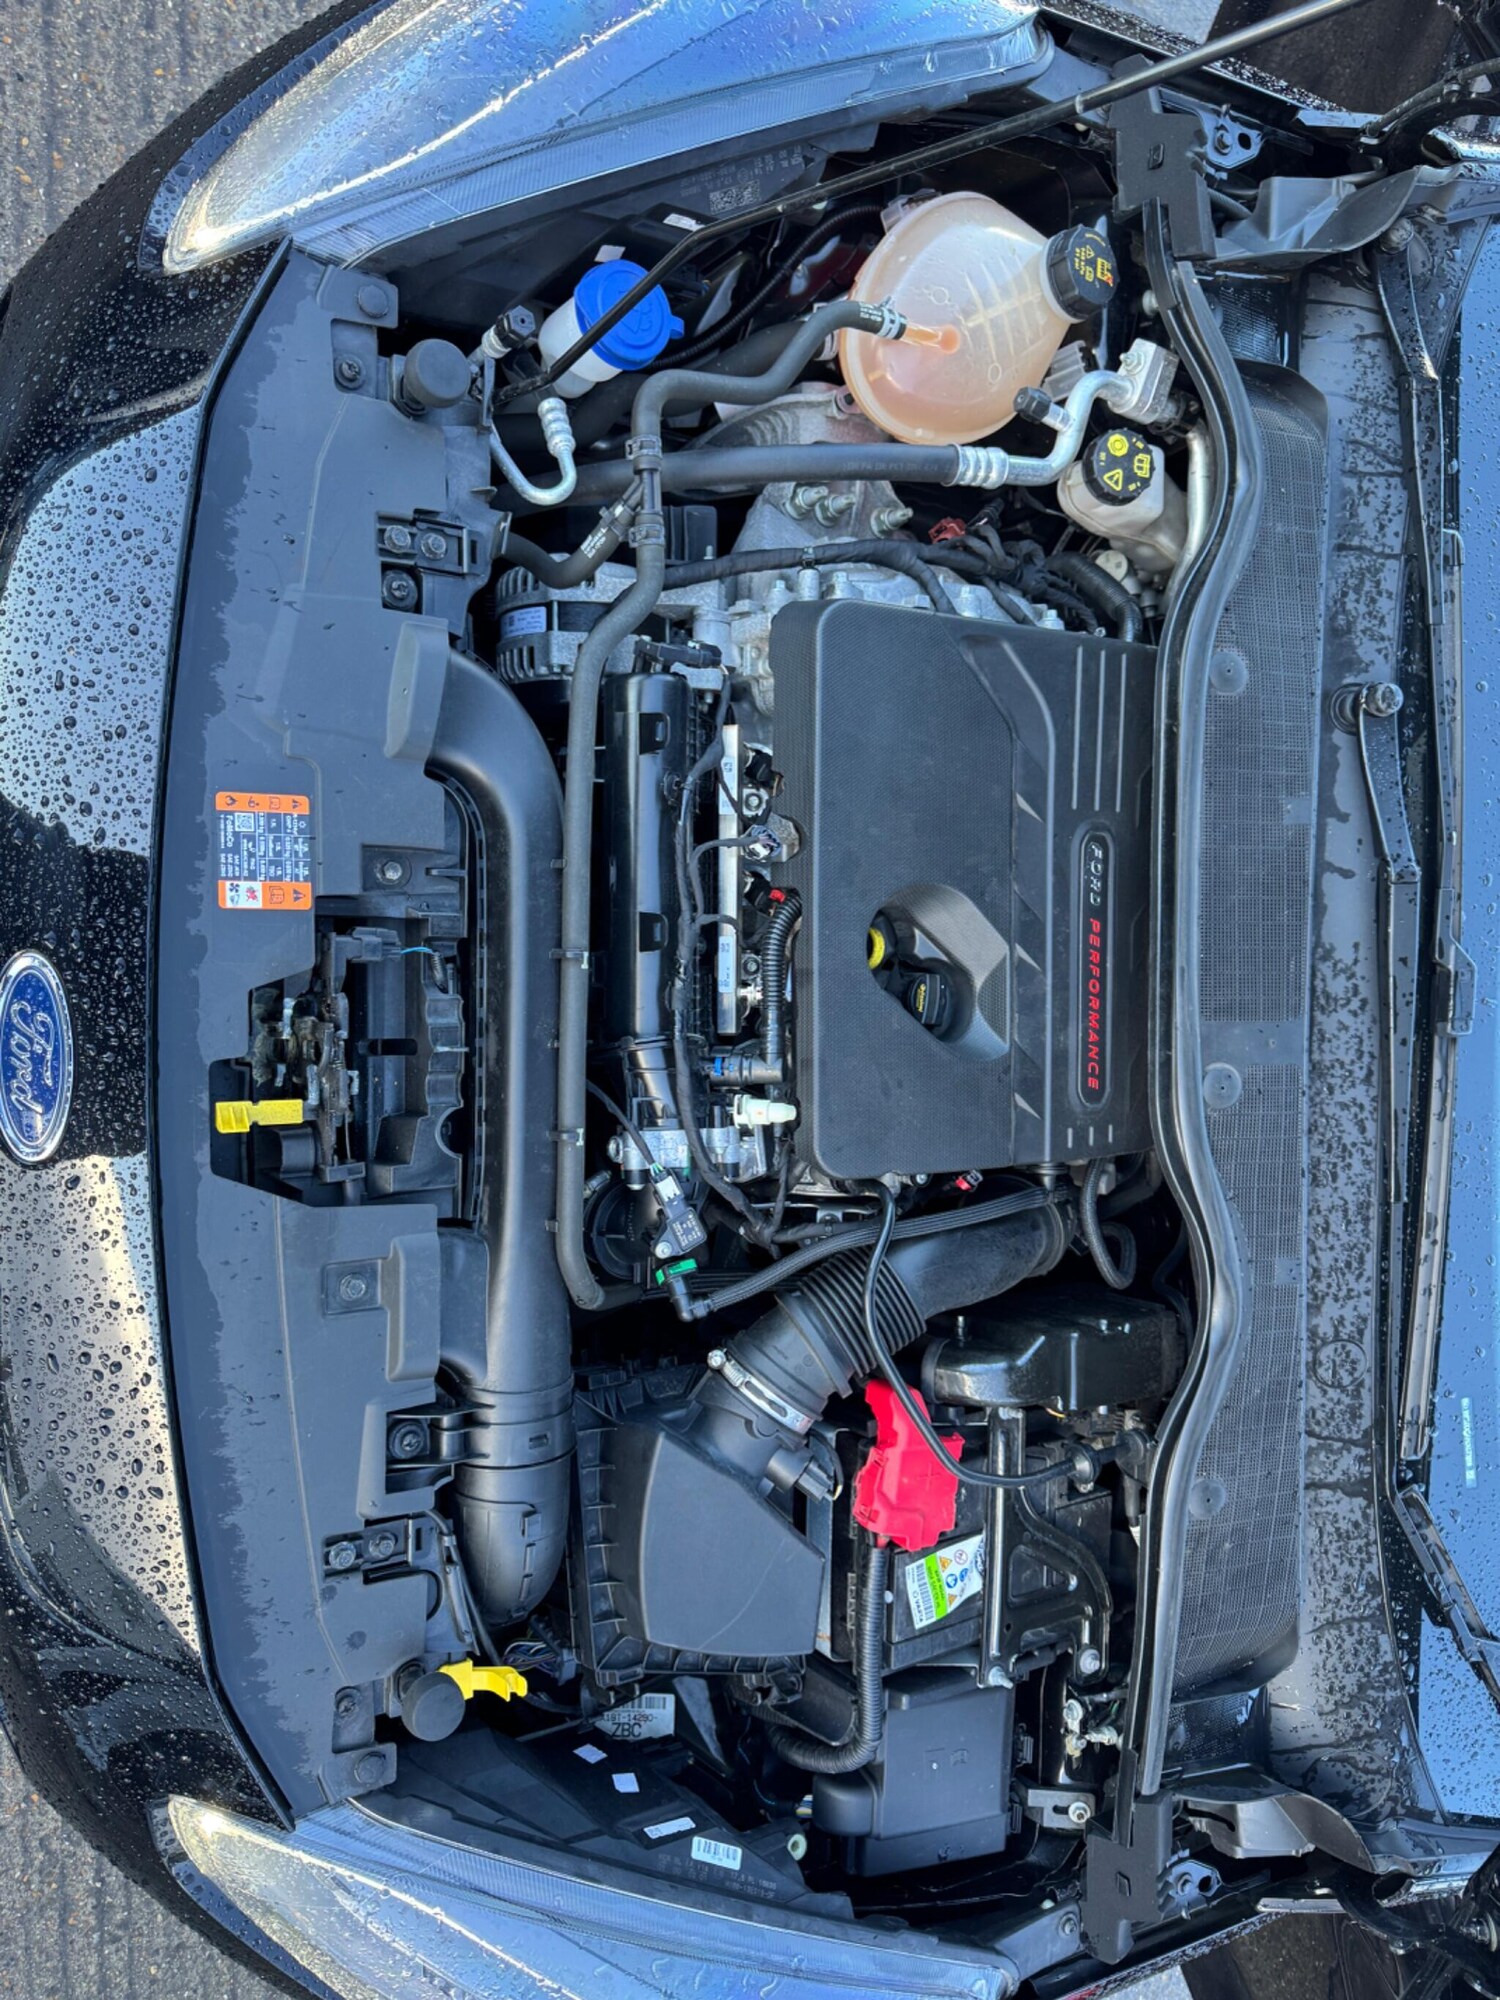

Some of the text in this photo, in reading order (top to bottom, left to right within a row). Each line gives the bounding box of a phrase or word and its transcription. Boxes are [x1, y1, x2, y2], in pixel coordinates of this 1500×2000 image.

[1087, 842, 1104, 1090] FORD PERFORMANCE
[10, 1001, 55, 1114] Ford
[611, 1722, 642, 1738] ZBC
